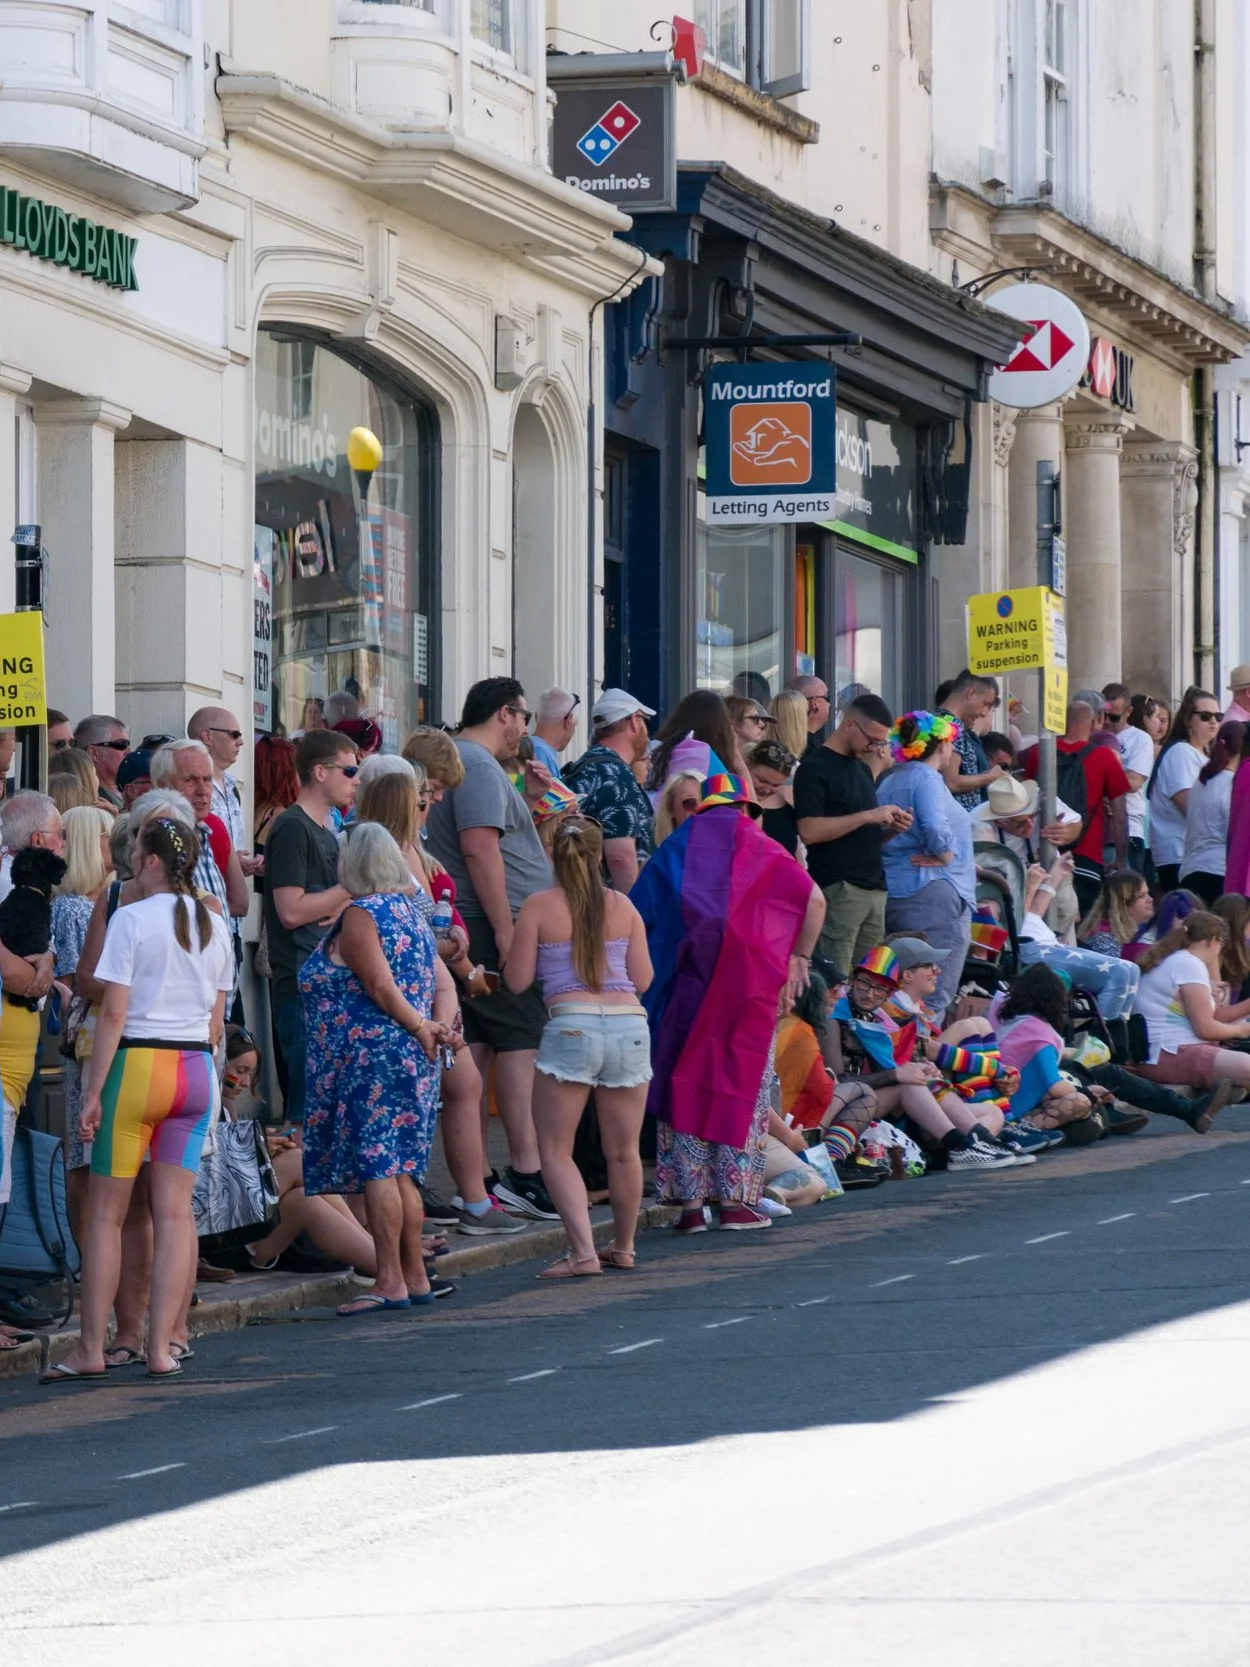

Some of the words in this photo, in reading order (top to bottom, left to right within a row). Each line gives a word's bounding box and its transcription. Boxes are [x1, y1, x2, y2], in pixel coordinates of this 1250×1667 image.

[565, 173, 650, 191] Domino's
[2, 185, 80, 268] LLOYDS
[85, 218, 140, 291] BANK
[1112, 346, 1134, 412] UK
[711, 379, 831, 400] Mountford
[254, 402, 338, 478] omino's
[712, 501, 768, 517] Letting
[773, 500, 830, 516] Agents
[976, 619, 1038, 638] WARNING
[986, 638, 1028, 653] Parking
[976, 652, 1039, 669] suspension
